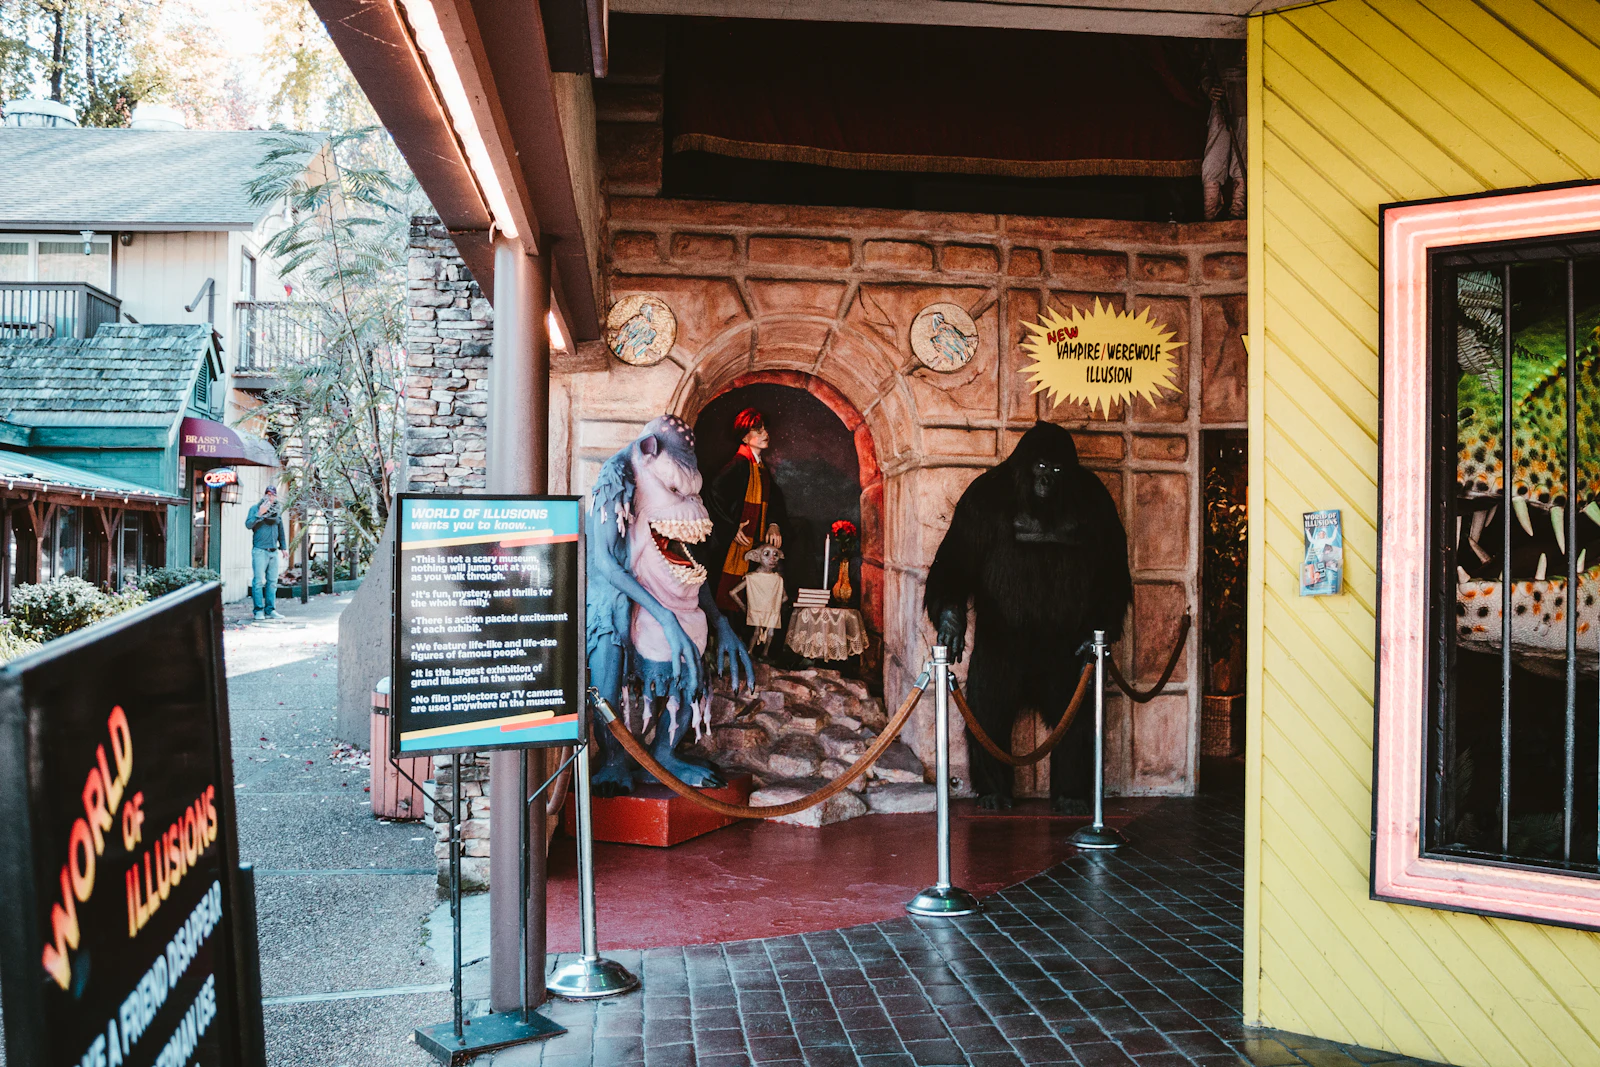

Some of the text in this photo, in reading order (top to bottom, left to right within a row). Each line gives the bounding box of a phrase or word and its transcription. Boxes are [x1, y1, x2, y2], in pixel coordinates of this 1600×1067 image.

[1047, 326, 1078, 345] NEW
[1087, 366, 1132, 383] ILLUSION
[185, 435, 229, 444] BRASSY'S
[197, 445, 217, 453] PUB
[204, 472, 237, 483] OPEN
[411, 508, 548, 519] WORLD OF ILLUSIONS
[411, 520, 535, 532] wants you to know...
[1305, 519, 1338, 528] ILLUSIONS
[438, 555, 445, 563] is
[473, 556, 497, 564] scary
[411, 564, 447, 573] nothing
[450, 564, 465, 572] will
[467, 564, 489, 573] jump
[424, 574, 441, 582] you
[467, 572, 505, 582] through.
[432, 590, 450, 599] fun,
[453, 589, 491, 602] mystery,
[493, 589, 510, 597] and
[539, 588, 552, 596] for
[411, 597, 489, 609] the whole family.
[455, 615, 483, 623] action
[485, 614, 517, 624] packed
[520, 613, 567, 621] excitement
[411, 624, 481, 634] at each exhibit.
[433, 642, 467, 650] feature
[469, 641, 502, 649] life-like
[504, 640, 521, 648] and
[523, 638, 557, 647] life-size
[411, 648, 526, 661] figures of famous people.
[425, 669, 432, 677] is
[435, 668, 450, 676] the
[453, 667, 484, 678] largest
[486, 665, 530, 675] exhibition
[533, 664, 542, 673] of
[411, 673, 535, 688] grand illusions in the world.
[431, 694, 449, 703] film
[452, 692, 498, 704] projectors
[512, 690, 524, 699] TV
[527, 689, 563, 698] cameras
[429, 703, 450, 712] used
[453, 701, 497, 712] anywhere
[499, 700, 507, 708] in
[510, 699, 524, 707] the
[526, 698, 565, 707] museum.
[123, 792, 145, 852] OF
[41, 705, 133, 991] WORLD
[125, 785, 218, 938] ILLUSIONS
[120, 955, 169, 1056] FRIEND
[166, 880, 223, 989] DISAPPEAR
[195, 973, 217, 1036] USE
